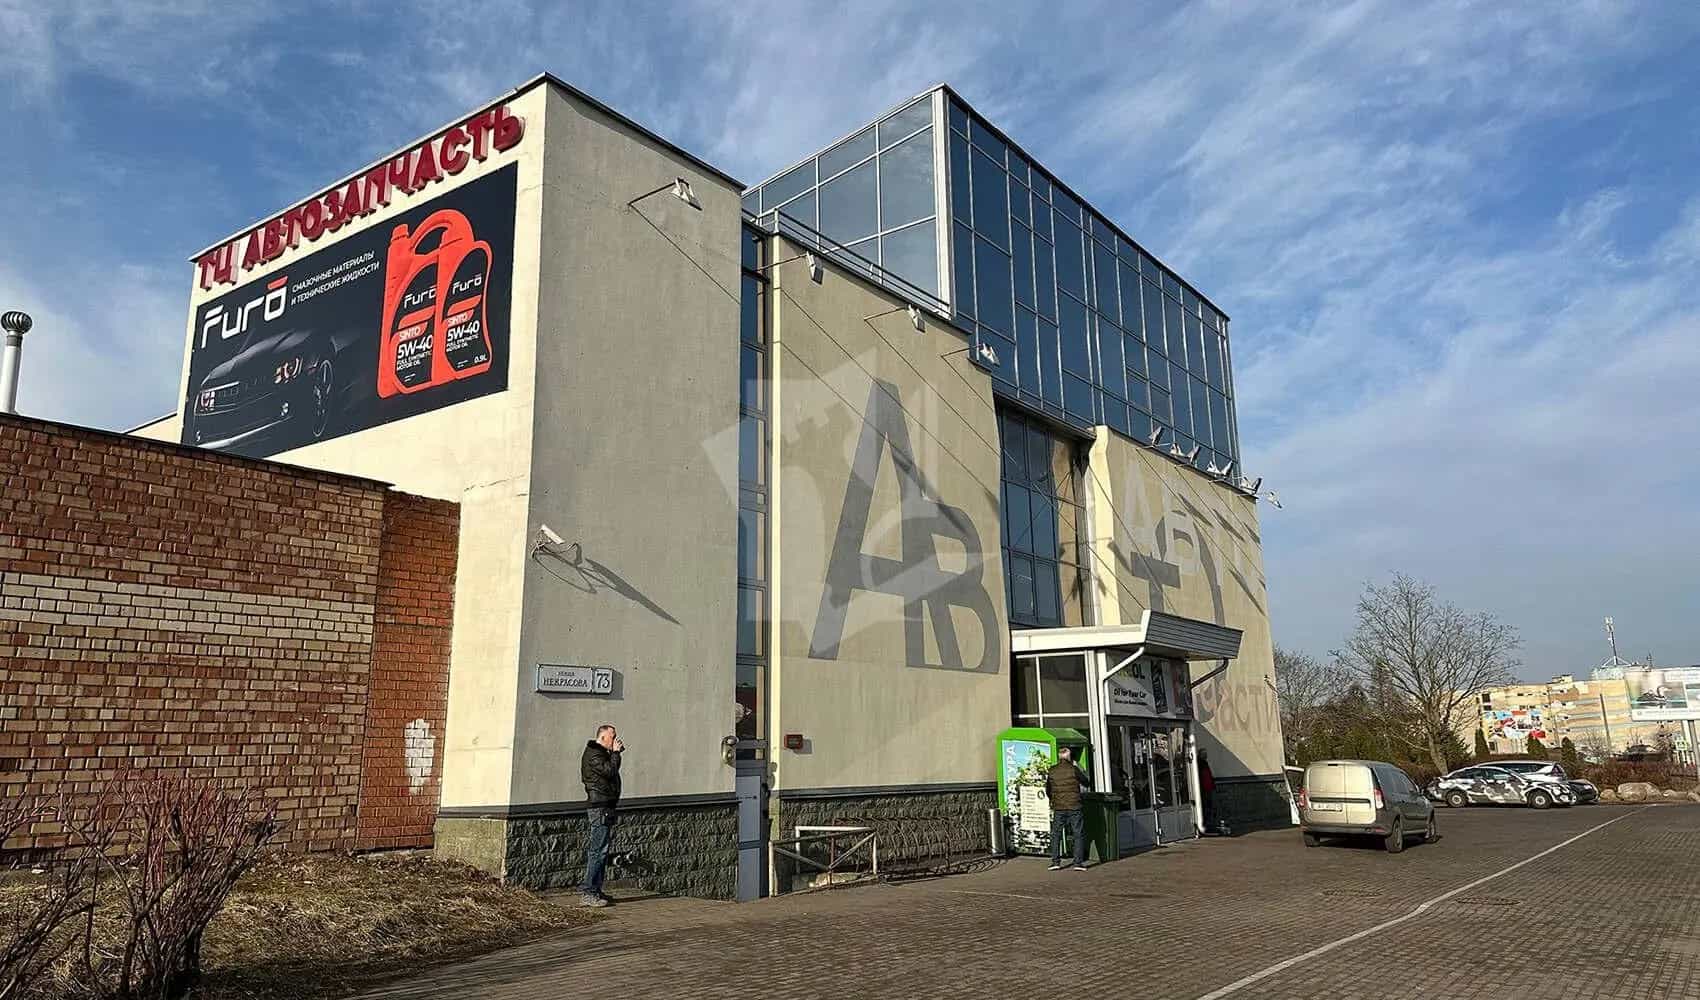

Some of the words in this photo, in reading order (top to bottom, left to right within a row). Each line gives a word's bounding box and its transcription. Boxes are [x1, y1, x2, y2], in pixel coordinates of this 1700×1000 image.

[199, 242, 240, 291] ТЦ
[242, 104, 525, 271] АВТОЗАПЧАСТЬ
[292, 269, 332, 293] СМАЗОЧНЫЕ
[333, 250, 375, 275] МАТЕРИАЛЫ
[297, 276, 342, 304] ТЕХНИЧЕСКИЕ
[341, 261, 380, 284] ЖИДКОСТИ
[397, 335, 433, 359] 5W-40
[447, 320, 480, 342] 5W-40
[542, 677, 588, 688] НЕКРАСОВА
[596, 672, 610, 688] 73
